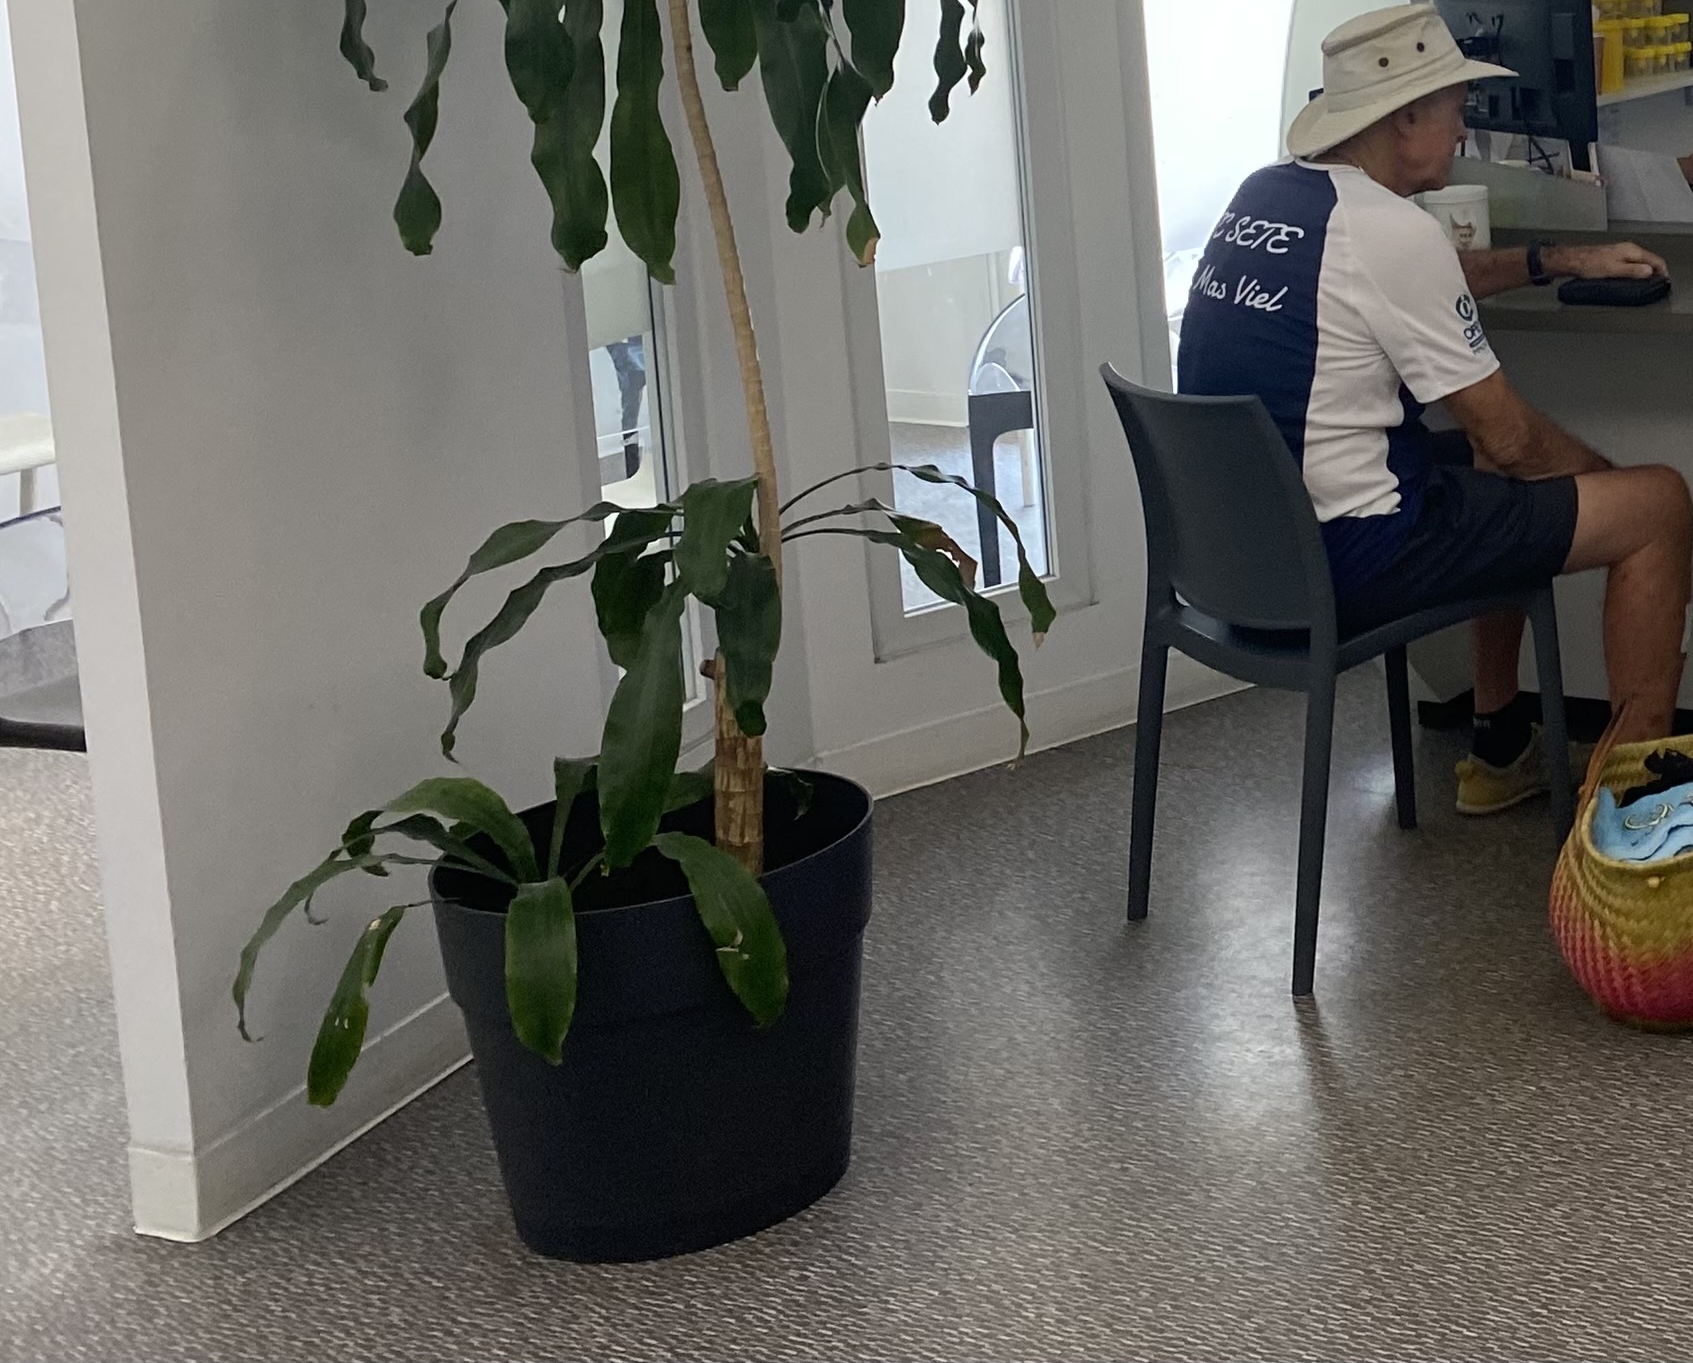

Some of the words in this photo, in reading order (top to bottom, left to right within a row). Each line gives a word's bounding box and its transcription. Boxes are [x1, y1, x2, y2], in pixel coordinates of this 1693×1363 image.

[1225, 215, 1305, 254] SETE
[1192, 263, 1227, 299] Mas
[1234, 274, 1289, 312] Viel
